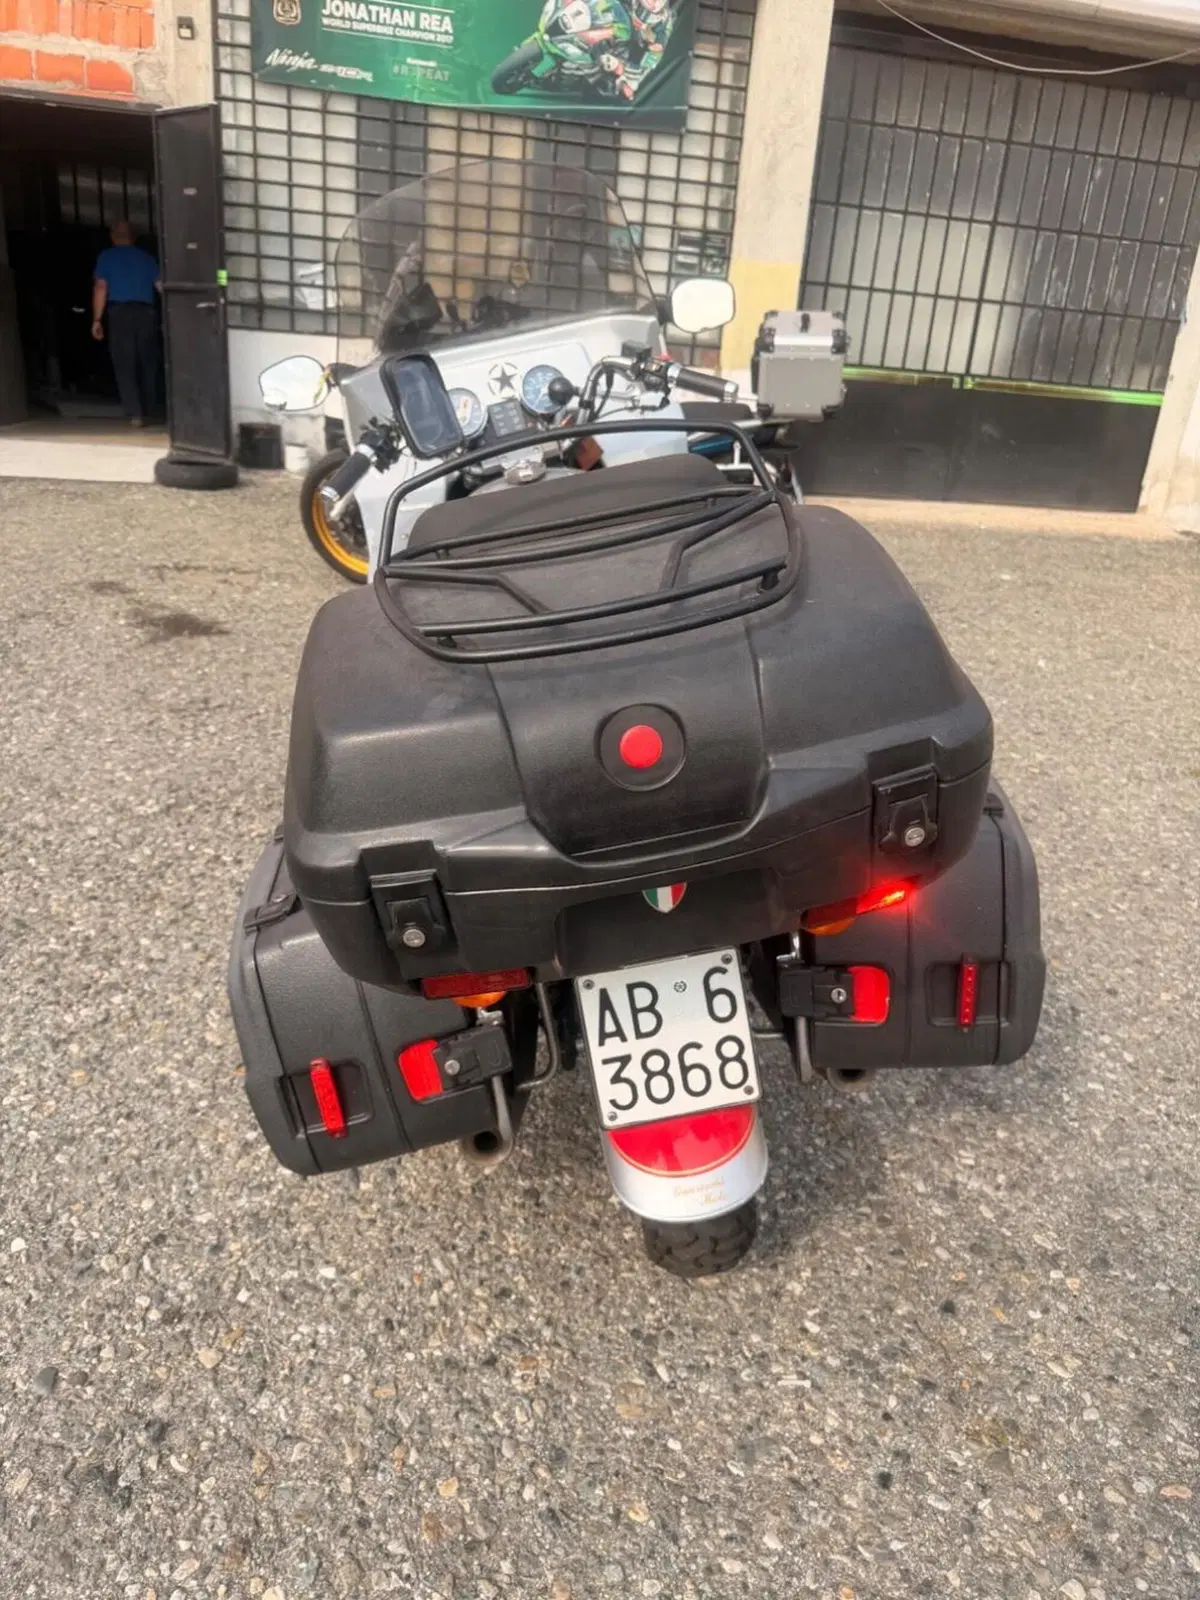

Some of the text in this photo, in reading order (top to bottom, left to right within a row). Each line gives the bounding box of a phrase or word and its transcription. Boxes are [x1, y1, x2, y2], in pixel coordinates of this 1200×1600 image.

[321, 0, 455, 34] JONATHAN REA
[321, 17, 351, 28] WORLD
[352, 21, 394, 35] SUPERBIKE
[395, 27, 436, 41] CHAMPION
[265, 48, 319, 72] Ninja
[598, 966, 738, 1047] AB 6
[601, 1034, 749, 1111] 3868
